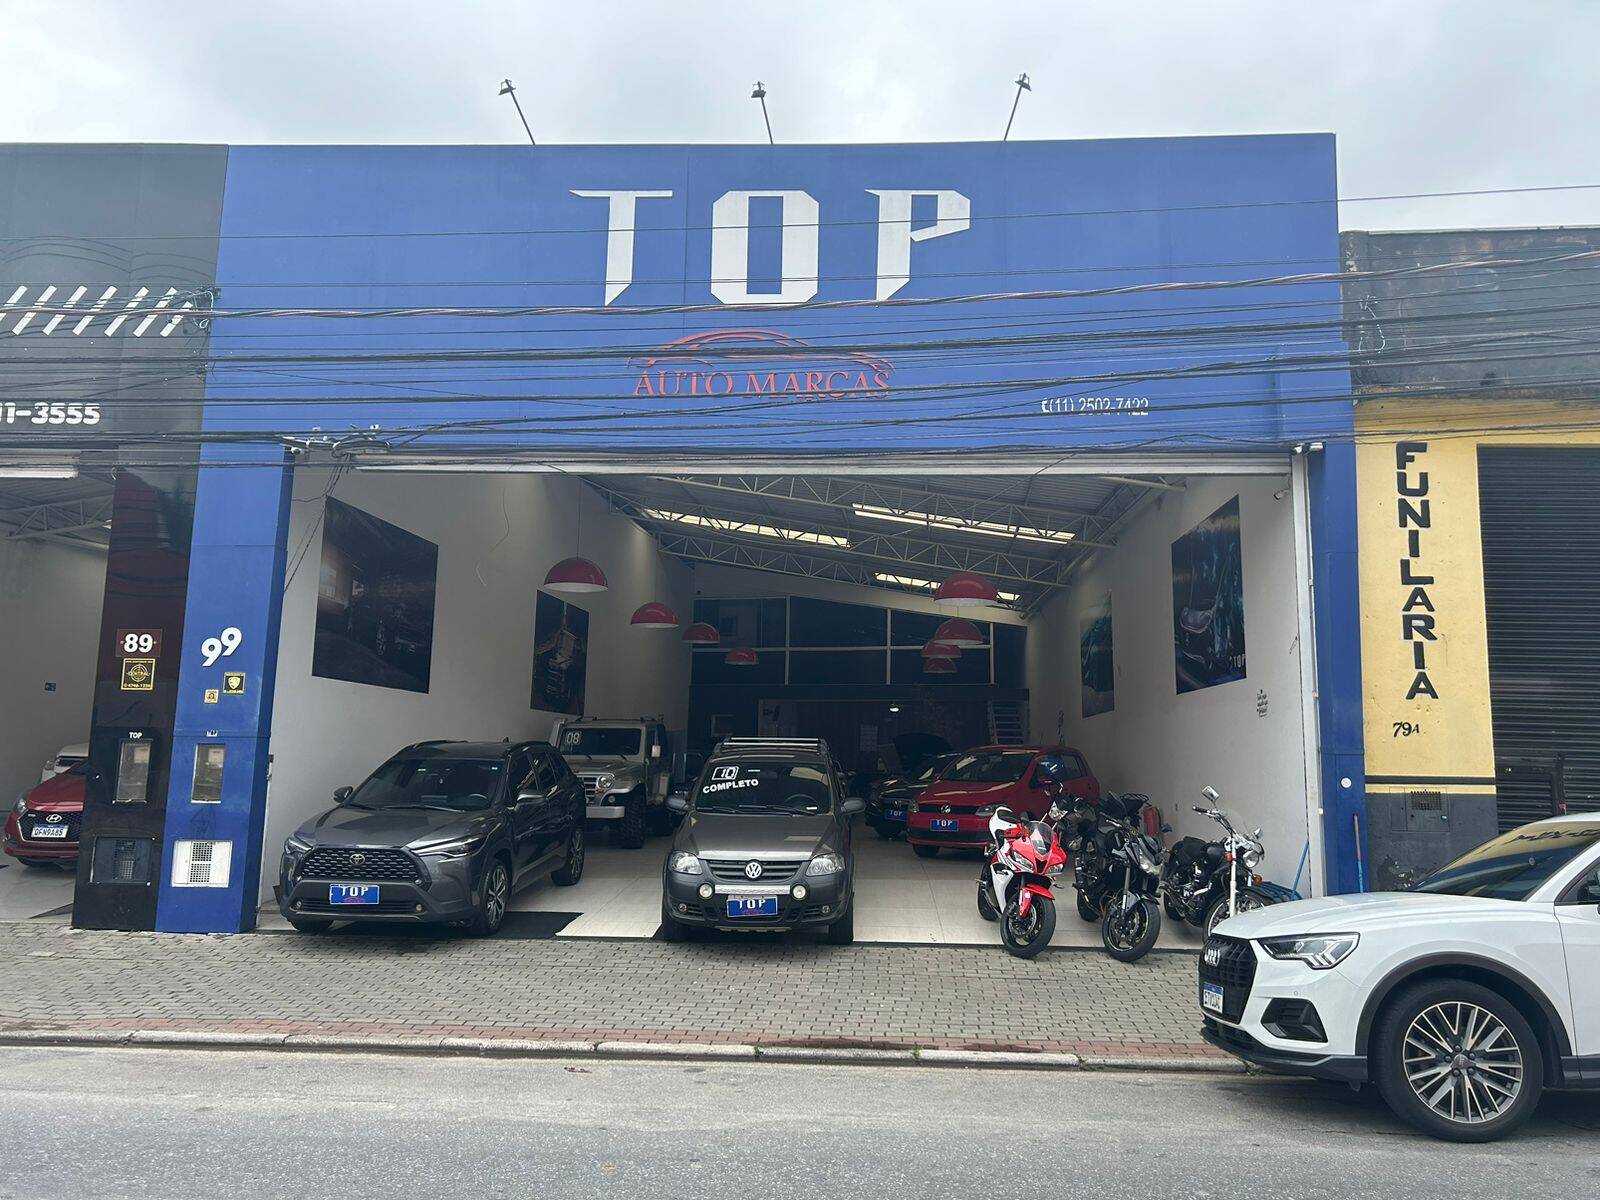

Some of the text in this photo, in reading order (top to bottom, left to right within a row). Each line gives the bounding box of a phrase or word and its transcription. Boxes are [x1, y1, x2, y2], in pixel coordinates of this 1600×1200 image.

[569, 189, 971, 307] TOP
[633, 370, 890, 399] AUTO MARCAS
[1396, 442, 1439, 700] FUNILARIA
[124, 633, 153, 653] 89
[201, 627, 242, 667] 99
[128, 731, 143, 739] TOP
[565, 731, 581, 744] 08
[702, 778, 759, 794] COMPLETO
[341, 885, 369, 897] TOP
